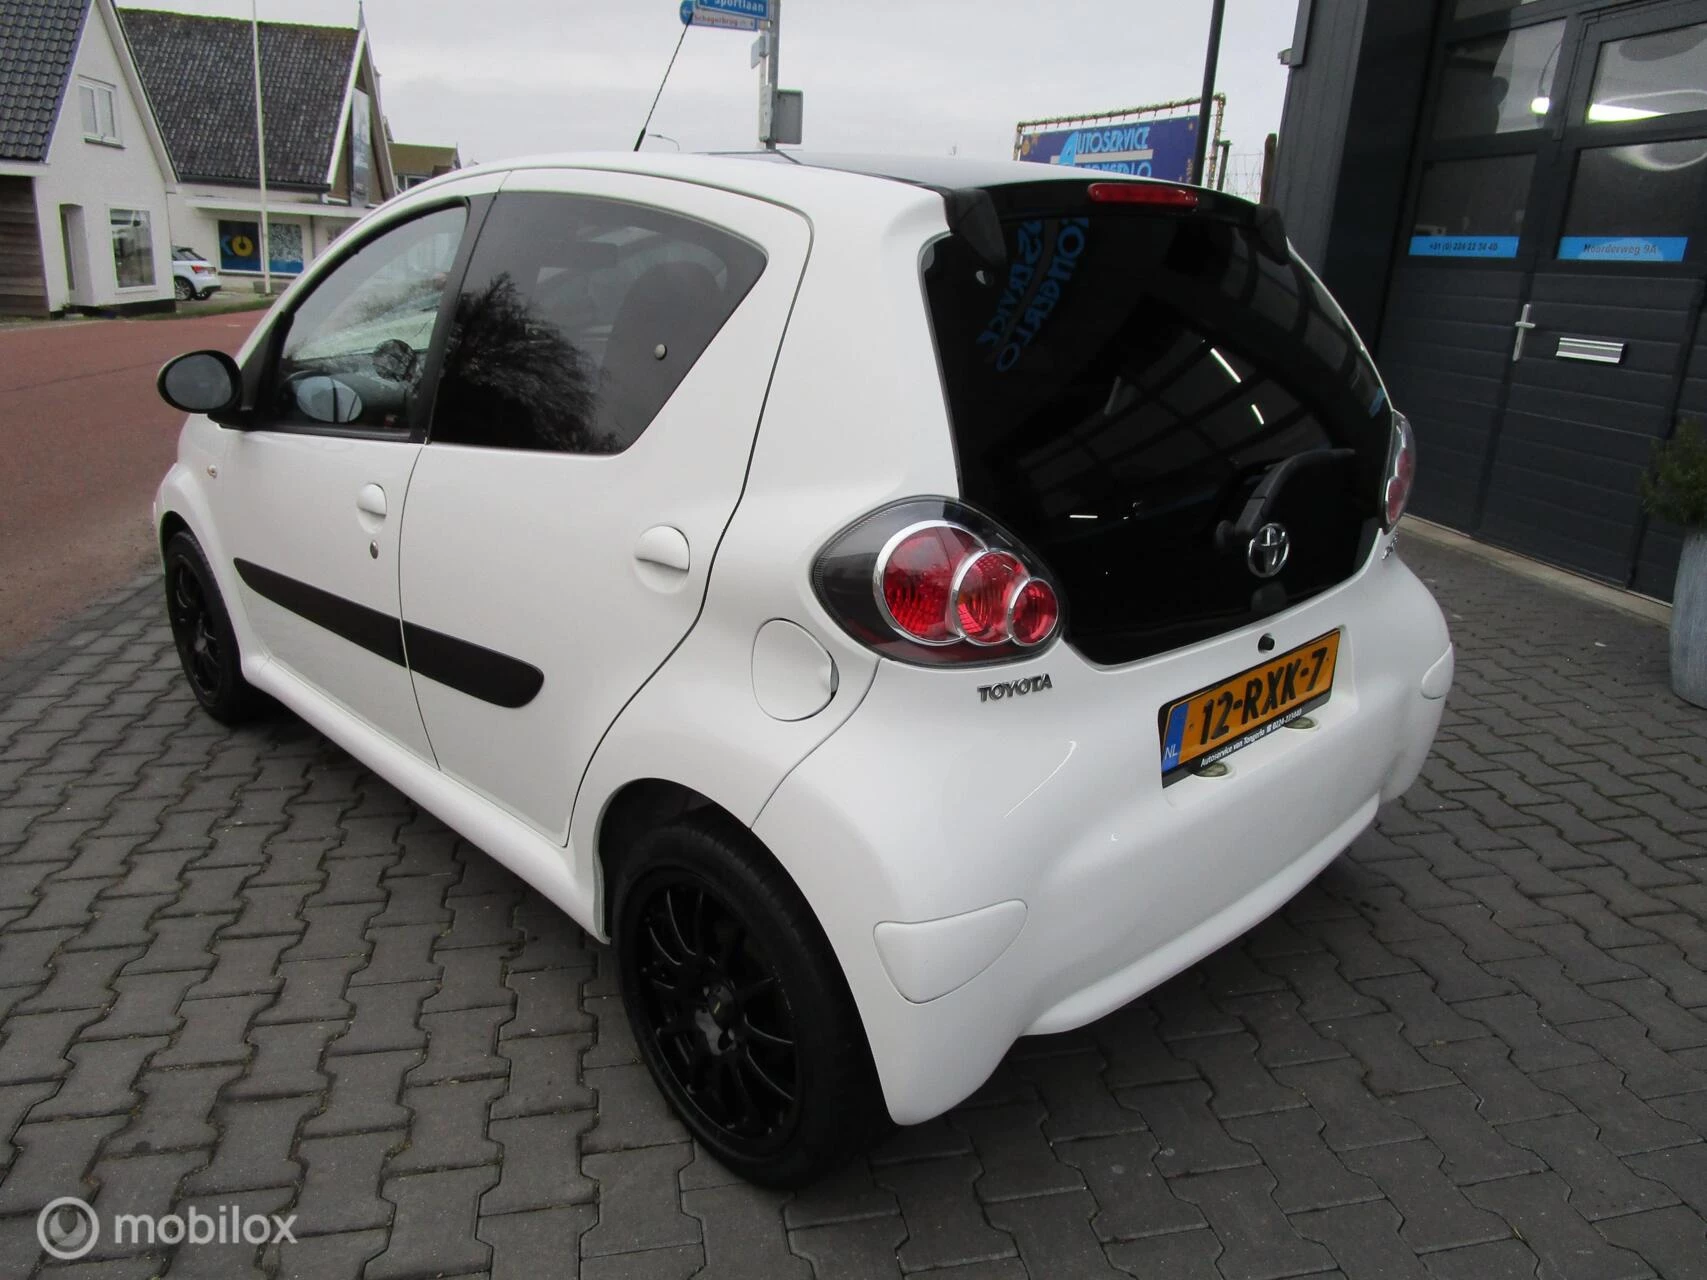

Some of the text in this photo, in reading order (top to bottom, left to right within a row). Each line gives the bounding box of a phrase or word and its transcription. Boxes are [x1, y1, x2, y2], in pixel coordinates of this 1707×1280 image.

[1058, 126, 1151, 166] AUTOSERVICE
[977, 673, 1053, 702] TOYOTA
[1200, 647, 1328, 745] 12-RXK-7
[1163, 744, 1178, 761] NL
[1200, 745, 1233, 767] Autoservice
[1233, 740, 1243, 751] van
